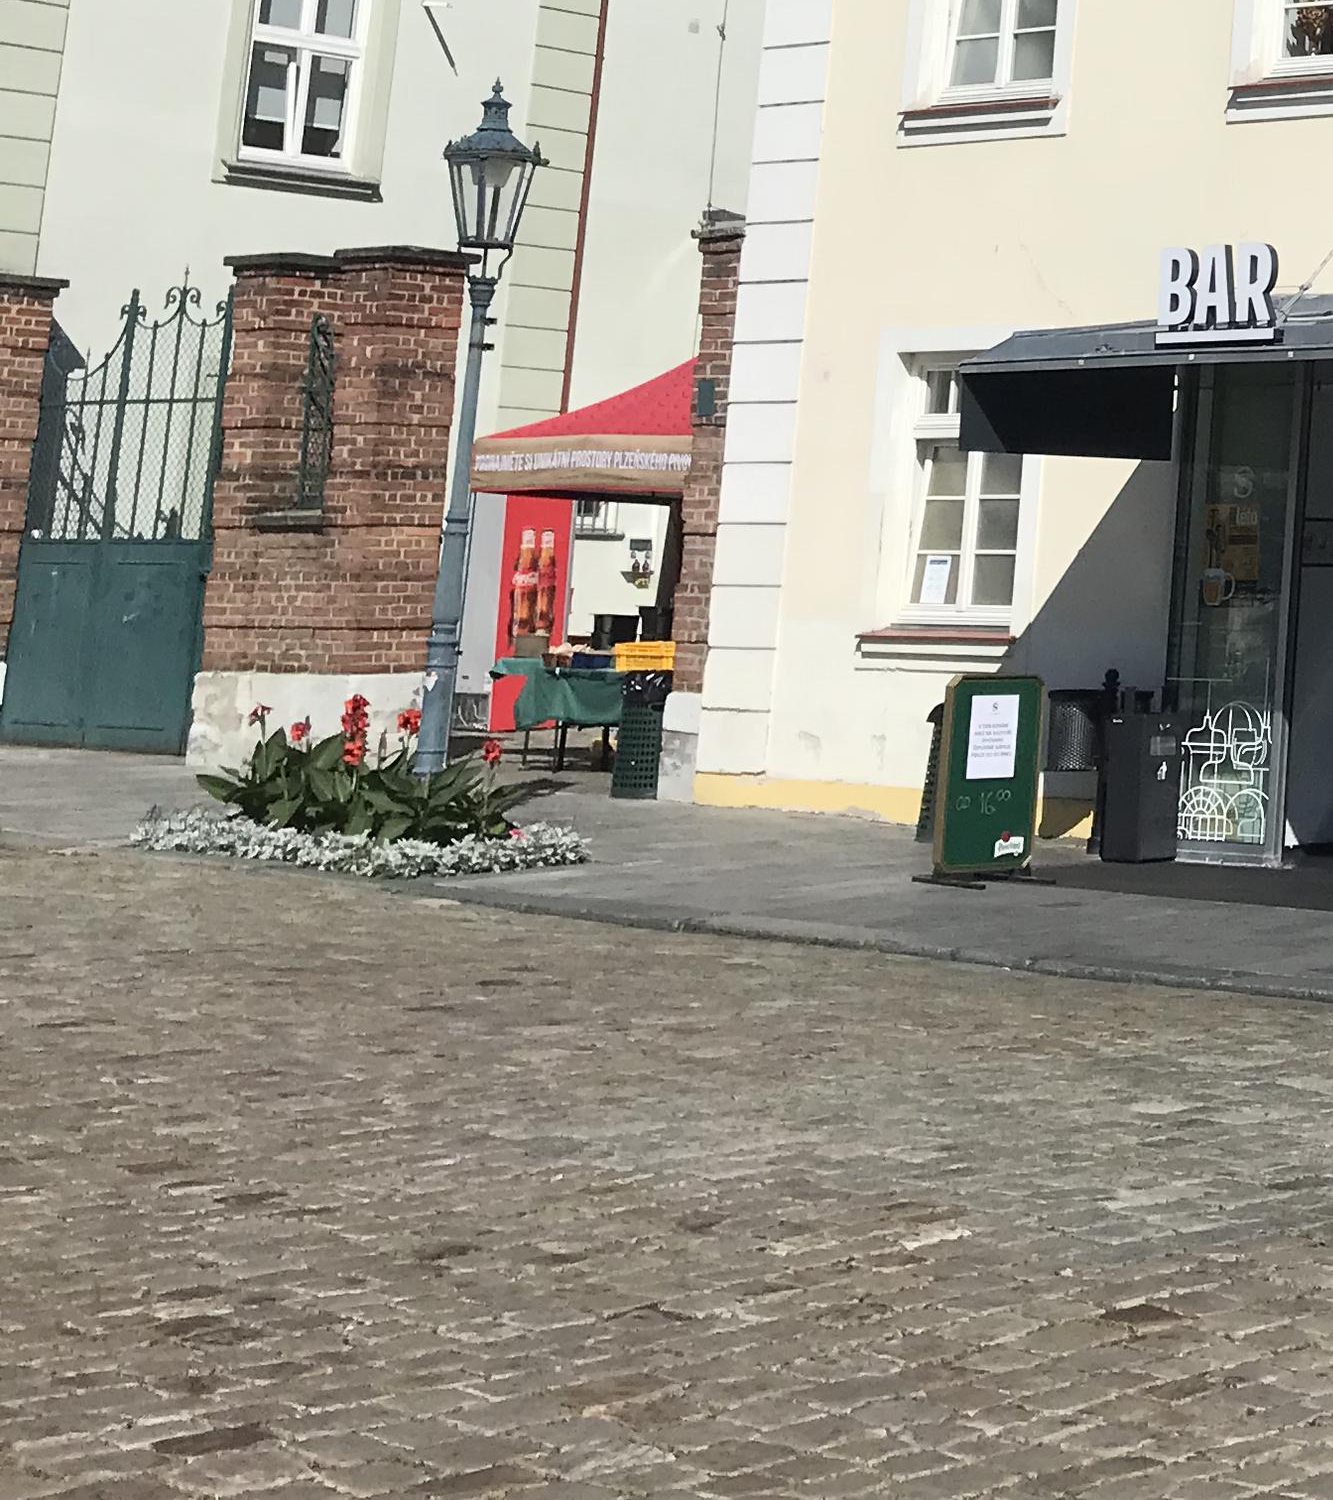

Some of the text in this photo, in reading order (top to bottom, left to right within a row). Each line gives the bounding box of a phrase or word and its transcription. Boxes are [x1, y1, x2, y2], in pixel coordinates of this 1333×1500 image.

[1157, 242, 1279, 327] BAR
[570, 451, 613, 468] PROSTORY
[614, 449, 667, 470] PLZEŇSKÉHO
